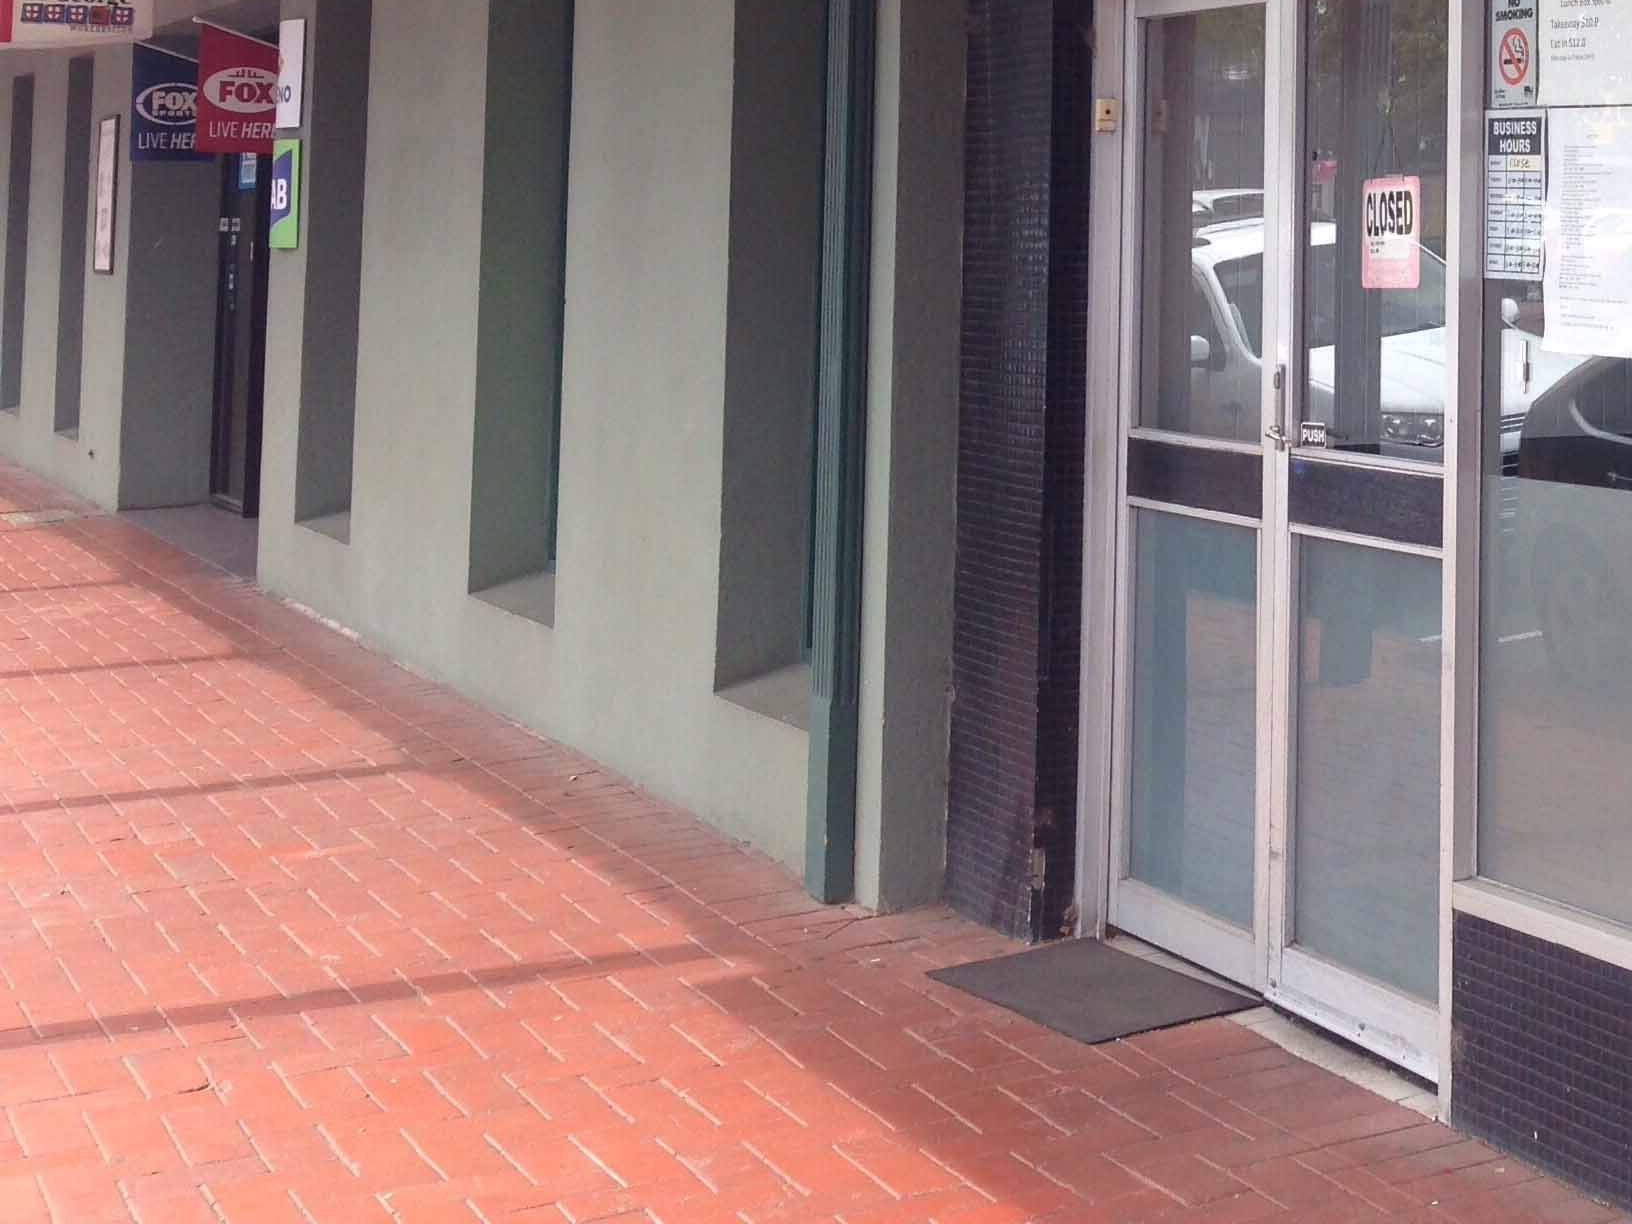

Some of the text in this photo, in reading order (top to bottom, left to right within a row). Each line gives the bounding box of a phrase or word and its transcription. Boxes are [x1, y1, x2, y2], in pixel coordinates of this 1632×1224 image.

[1495, 7, 1534, 22] SMOKING
[151, 90, 198, 110] FOX
[219, 80, 274, 105] FOX
[209, 121, 240, 139] LIVE
[1493, 121, 1537, 136] BUSINESS
[138, 132, 169, 150] LIVE
[1499, 138, 1531, 154] HOURS
[1366, 189, 1414, 238] CLOSED
[1302, 428, 1326, 444] PUSH
